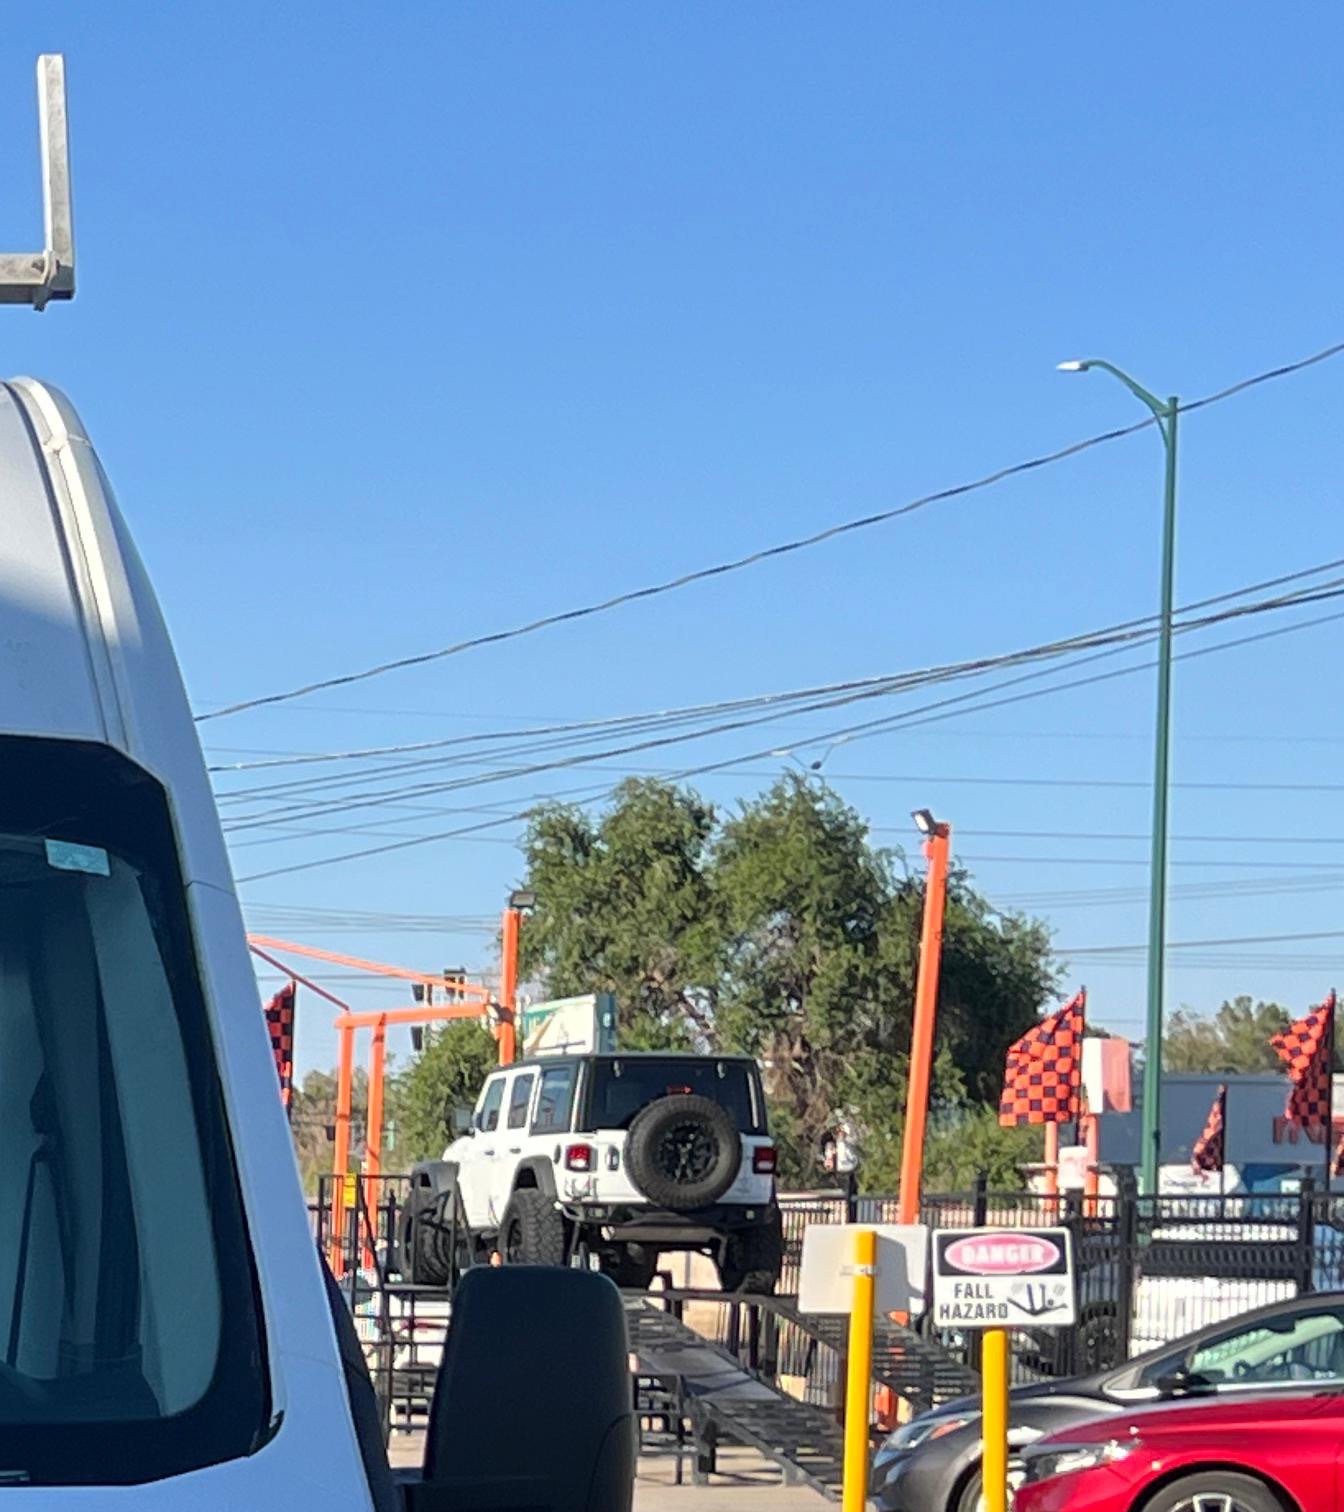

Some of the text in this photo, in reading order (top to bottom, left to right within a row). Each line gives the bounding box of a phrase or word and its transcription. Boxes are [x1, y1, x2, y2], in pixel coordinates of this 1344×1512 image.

[961, 1244, 1044, 1264] DANGER
[954, 1283, 994, 1299] FALL
[940, 1303, 1008, 1320] HAZARD
